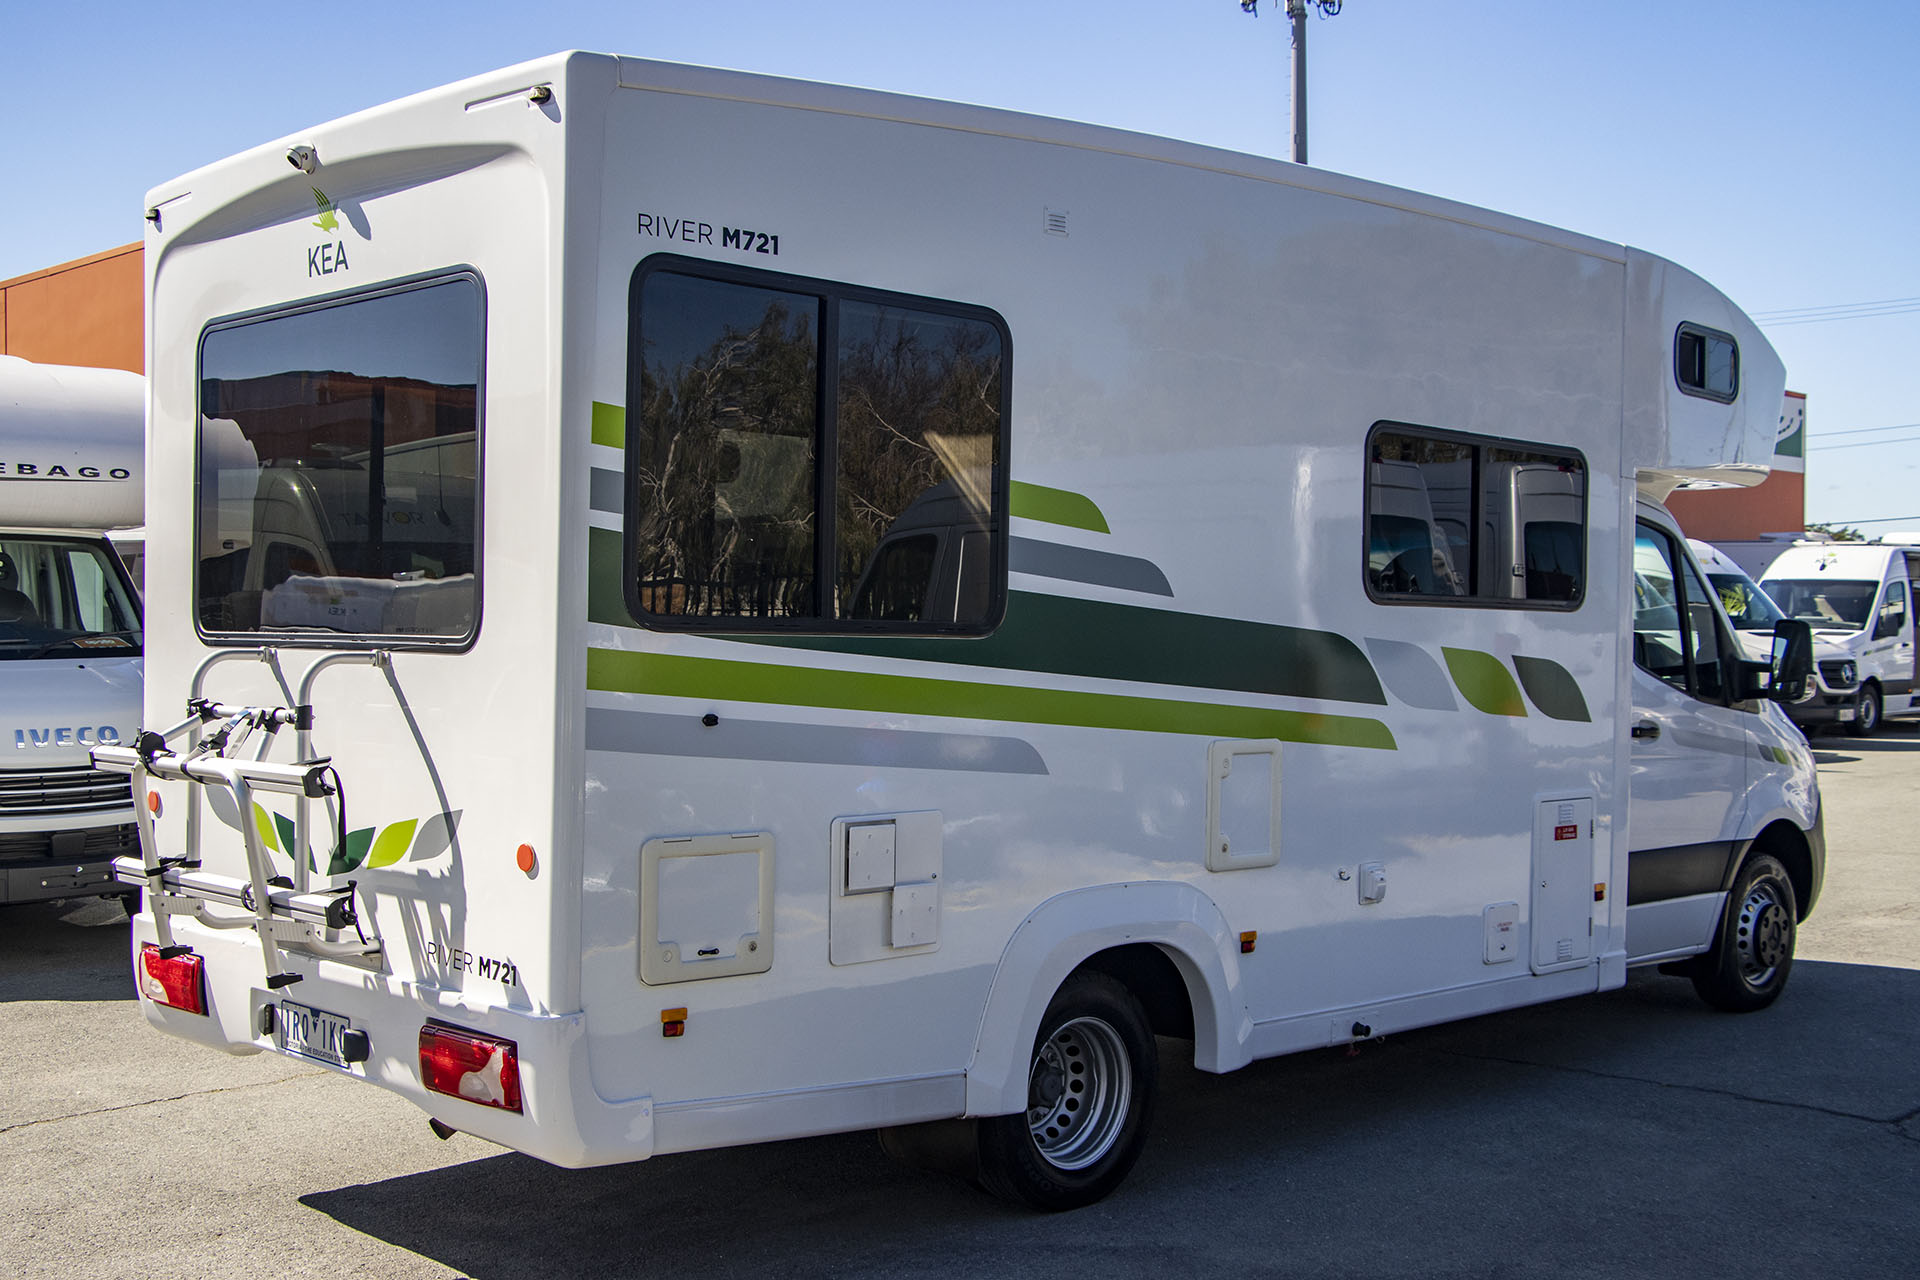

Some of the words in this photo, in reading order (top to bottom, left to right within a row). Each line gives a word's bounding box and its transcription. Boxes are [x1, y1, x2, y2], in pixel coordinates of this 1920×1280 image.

[638, 212, 713, 246] RIVER
[722, 226, 779, 256] M721
[307, 240, 350, 278] KEA
[14, 725, 120, 749] IVECO
[427, 941, 473, 975] RIVER
[478, 955, 518, 987] M721
